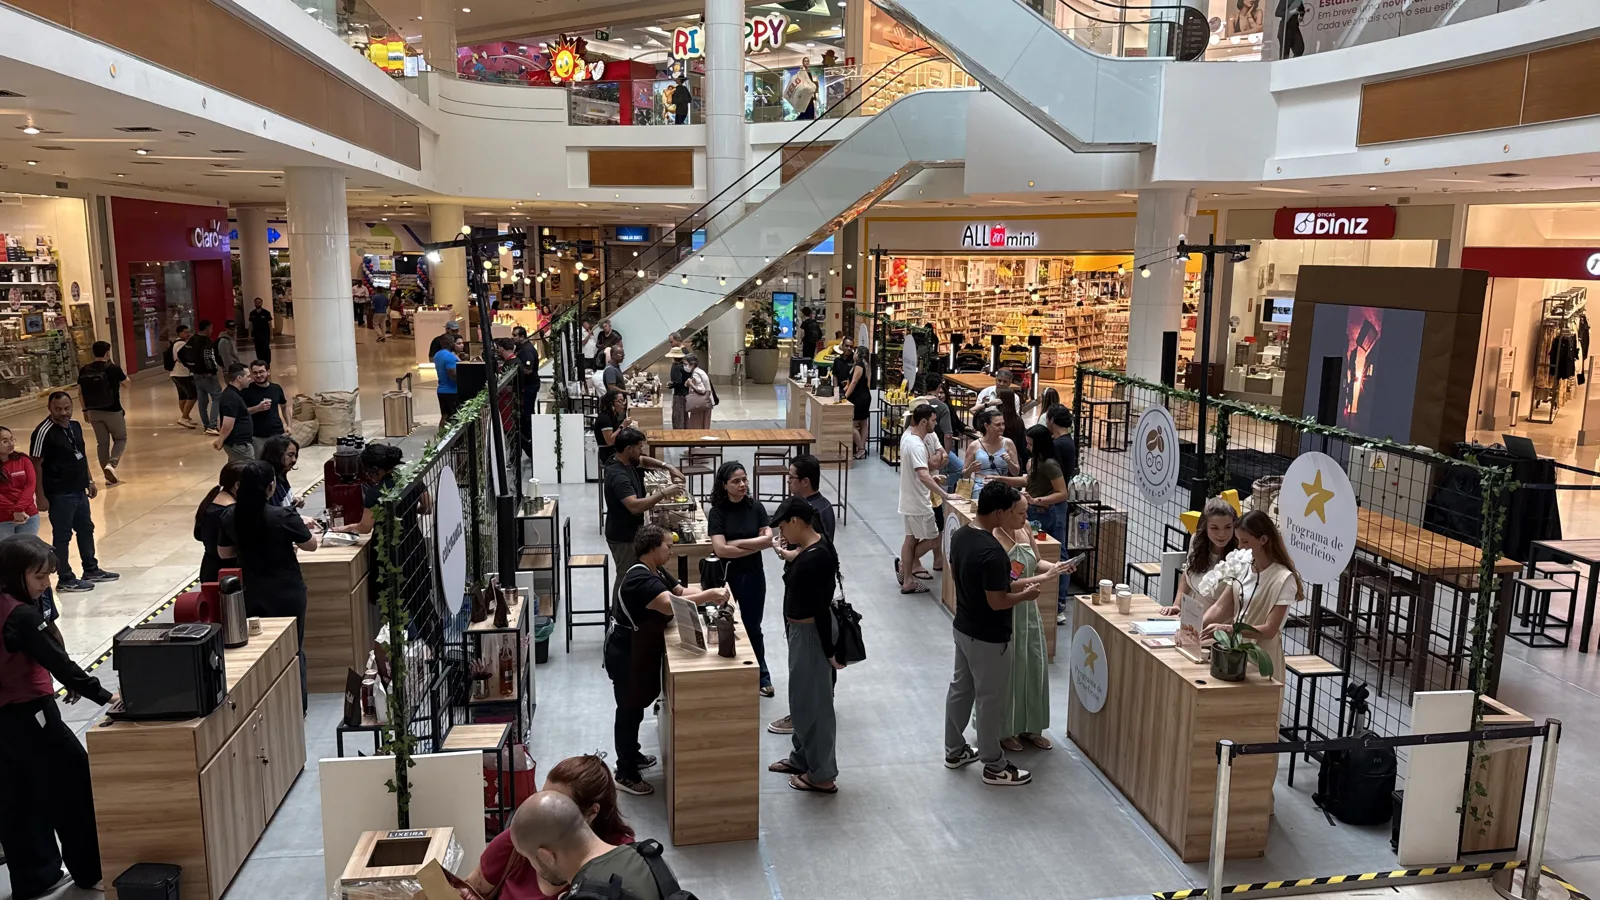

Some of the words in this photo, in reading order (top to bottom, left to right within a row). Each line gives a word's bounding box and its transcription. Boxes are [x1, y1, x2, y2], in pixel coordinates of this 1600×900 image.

[1316, 21, 1340, 31] Cada
[1358, 13, 1381, 24] mais
[1382, 11, 1403, 21] com
[1405, 9, 1413, 17] o
[1414, 6, 1432, 15] seu
[1317, 11, 1331, 20] Em
[1332, 6, 1358, 17] breve
[675, 28, 700, 55] RI
[194, 224, 220, 248] Claro
[962, 224, 989, 246] ALL
[1006, 231, 1035, 246] mini
[1315, 218, 1369, 235] DINIZ
[1286, 516, 1329, 546] Programa
[1330, 536, 1344, 552] de
[1290, 533, 1336, 564] Benefícios
